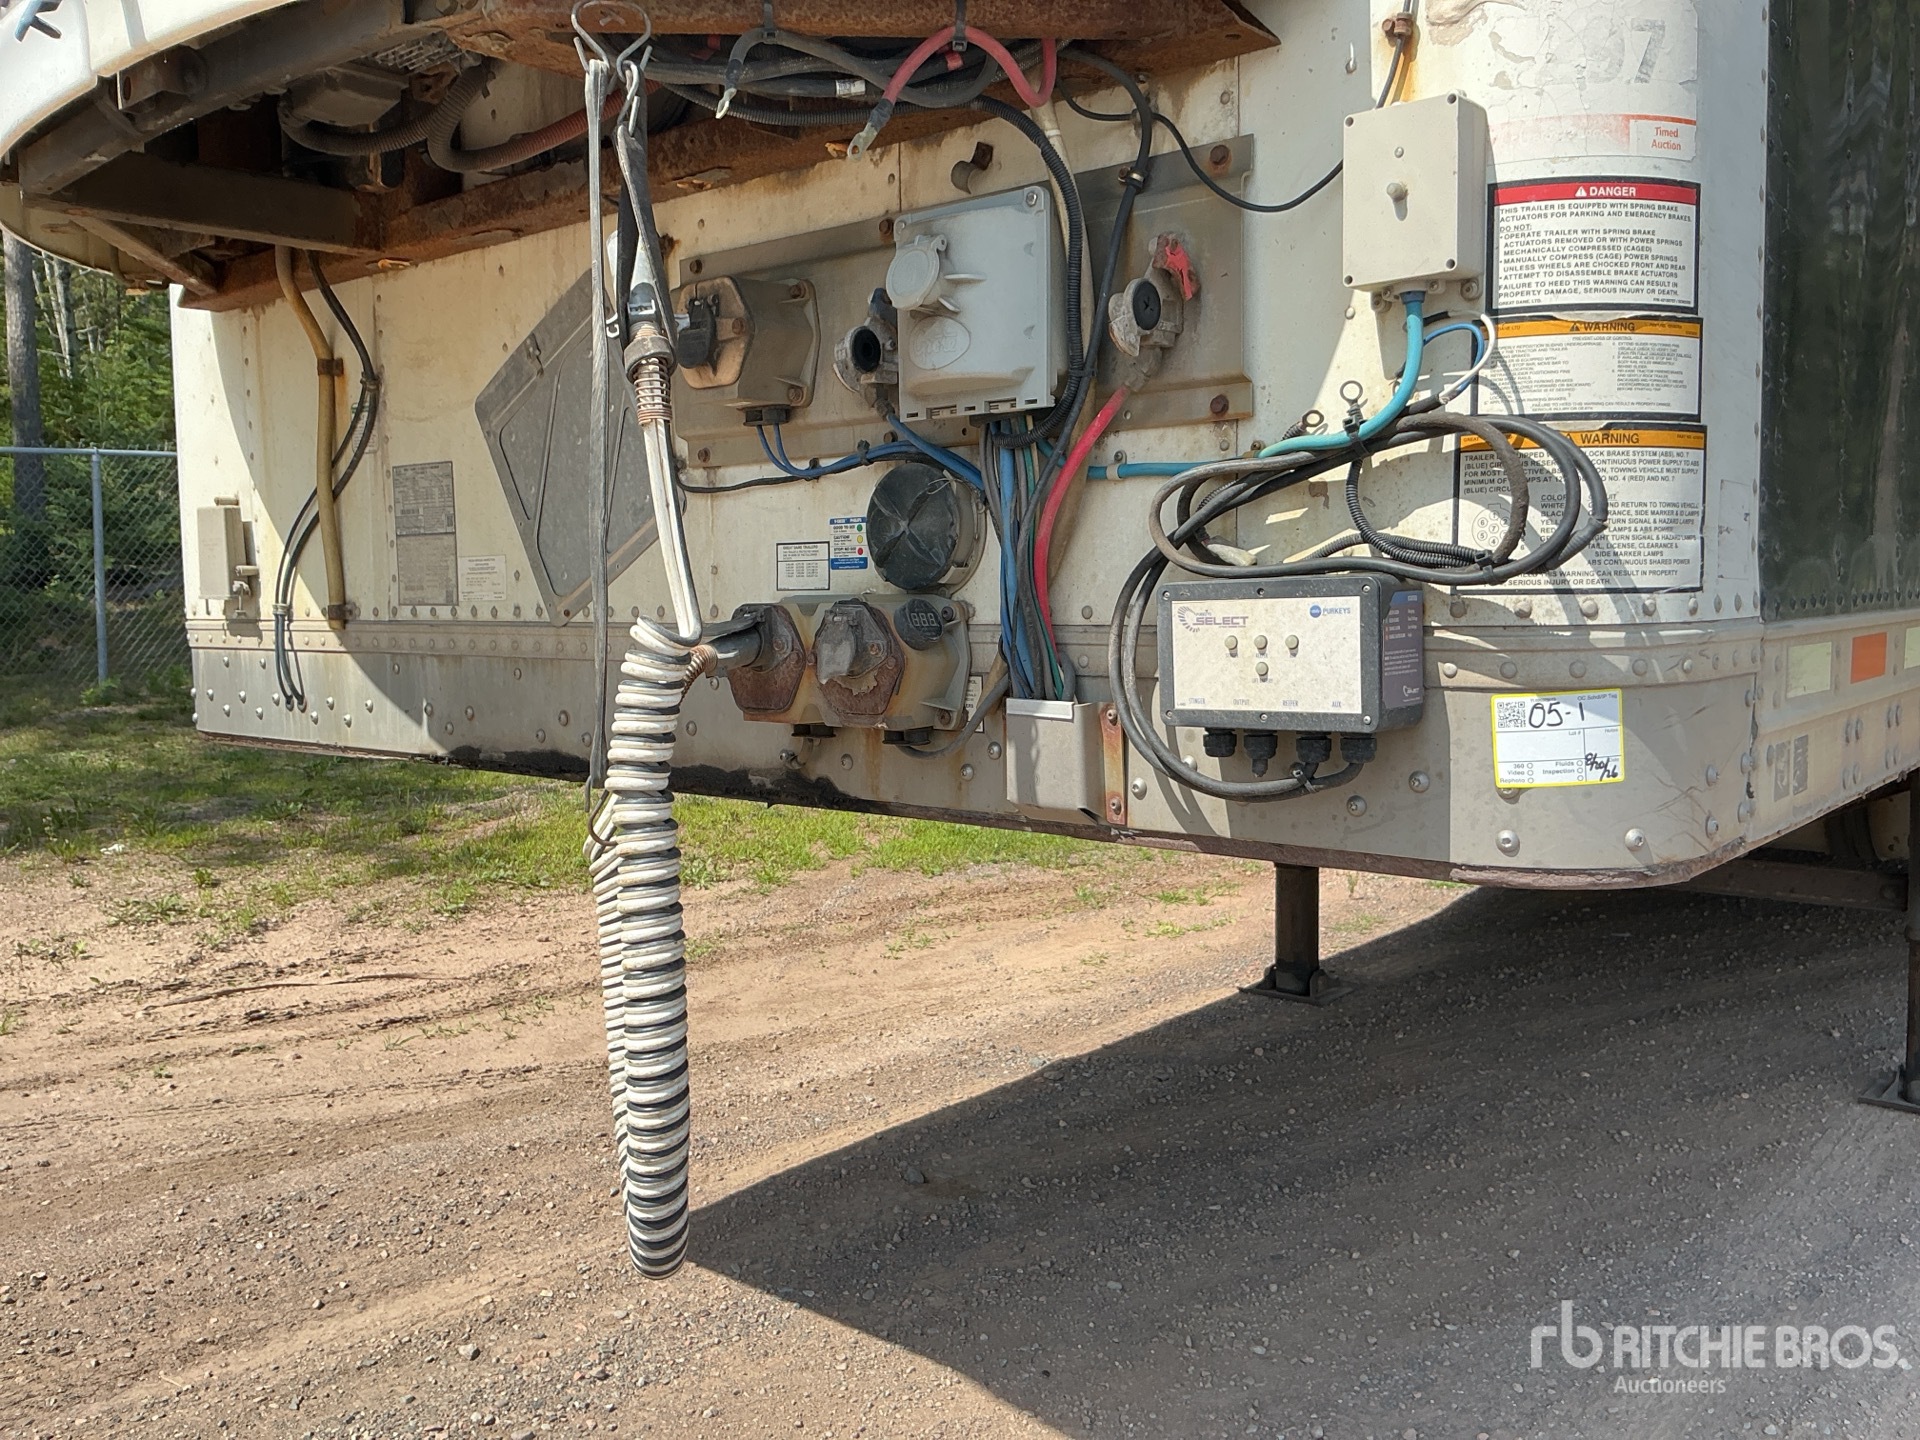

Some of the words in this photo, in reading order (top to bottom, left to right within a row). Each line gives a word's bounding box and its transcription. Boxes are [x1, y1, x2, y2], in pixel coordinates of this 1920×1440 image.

[1654, 126, 1679, 138] Timed
[1651, 139, 1682, 151] Auction
[1589, 186, 1636, 197] DANGER
[1521, 204, 1555, 213] TRAILER
[1568, 202, 1607, 210] EQUIPPED
[1657, 204, 1679, 212] BRAKE
[1500, 212, 1548, 223] ACTUATORS
[1624, 211, 1667, 220] EMERGENCY
[1668, 214, 1692, 222] BRAKES.
[1504, 230, 1542, 240] OPERATE
[1602, 228, 1631, 236] SPRING
[1504, 238, 1552, 248] ACTUATORS
[1656, 238, 1683, 247] SPRINGS
[1504, 246, 1566, 256] MECHANICALLY
[1568, 244, 1622, 252] COMPRESSED
[1624, 245, 1652, 253] (CAGED)
[1504, 254, 1548, 264] MANUALLY
[1549, 253, 1594, 261] COMPRESS
[1650, 254, 1678, 262] SPRINGS
[1503, 264, 1536, 272] UNLESS
[1538, 262, 1572, 270] WHEELS
[1503, 272, 1541, 281] ATTEMPT
[1543, 270, 1554, 278] TO
[1556, 269, 1612, 277] DISASSEMBLE
[1640, 270, 1678, 279] ACTUATORS
[1499, 282, 1533, 290] FAILURE
[1646, 280, 1670, 288] RESULT
[1498, 290, 1542, 298] PROPERTY
[1544, 288, 1581, 296] DAMAGE,
[1657, 288, 1679, 296] DEATH.
[1584, 322, 1636, 332] WARNING
[1580, 432, 1640, 444] WARNING
[1464, 454, 1495, 462] TRAILER
[1464, 462, 1488, 471] (BLUE)
[1592, 458, 1637, 466] CONTINUOUS
[1464, 470, 1478, 478] FOR
[1464, 478, 1495, 486] MINIMUM
[1464, 486, 1488, 496] (BLUE)
[1610, 534, 1630, 542] TURN
[1606, 542, 1637, 550] LICENSE,
[1587, 558, 1602, 566] ABS
[1603, 558, 1648, 566] CONTINUOUS
[1648, 558, 1672, 566] SHARED
[1672, 558, 1691, 566] POWER
[1586, 578, 1612, 586] DEATH.
[1193, 616, 1249, 626] SELECT
[1542, 768, 1575, 776] Inspection
